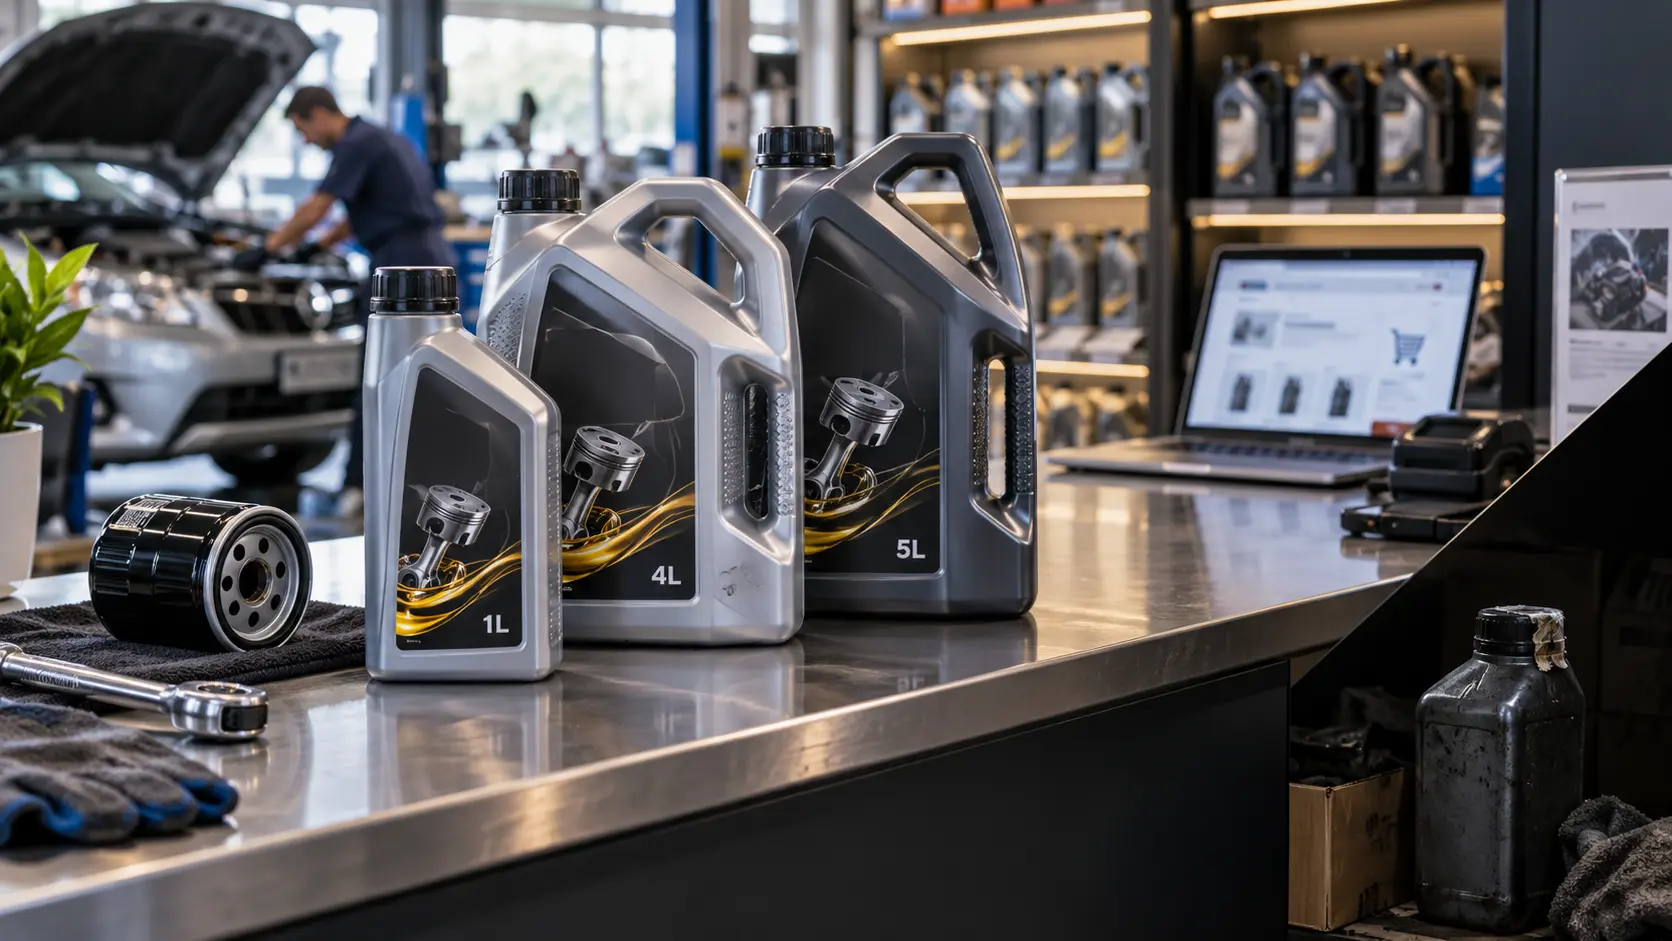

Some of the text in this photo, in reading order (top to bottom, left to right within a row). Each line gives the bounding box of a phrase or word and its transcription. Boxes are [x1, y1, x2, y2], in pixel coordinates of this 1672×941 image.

[896, 539, 926, 559] 5L
[651, 566, 682, 585] 4L
[483, 614, 510, 634] 1L
